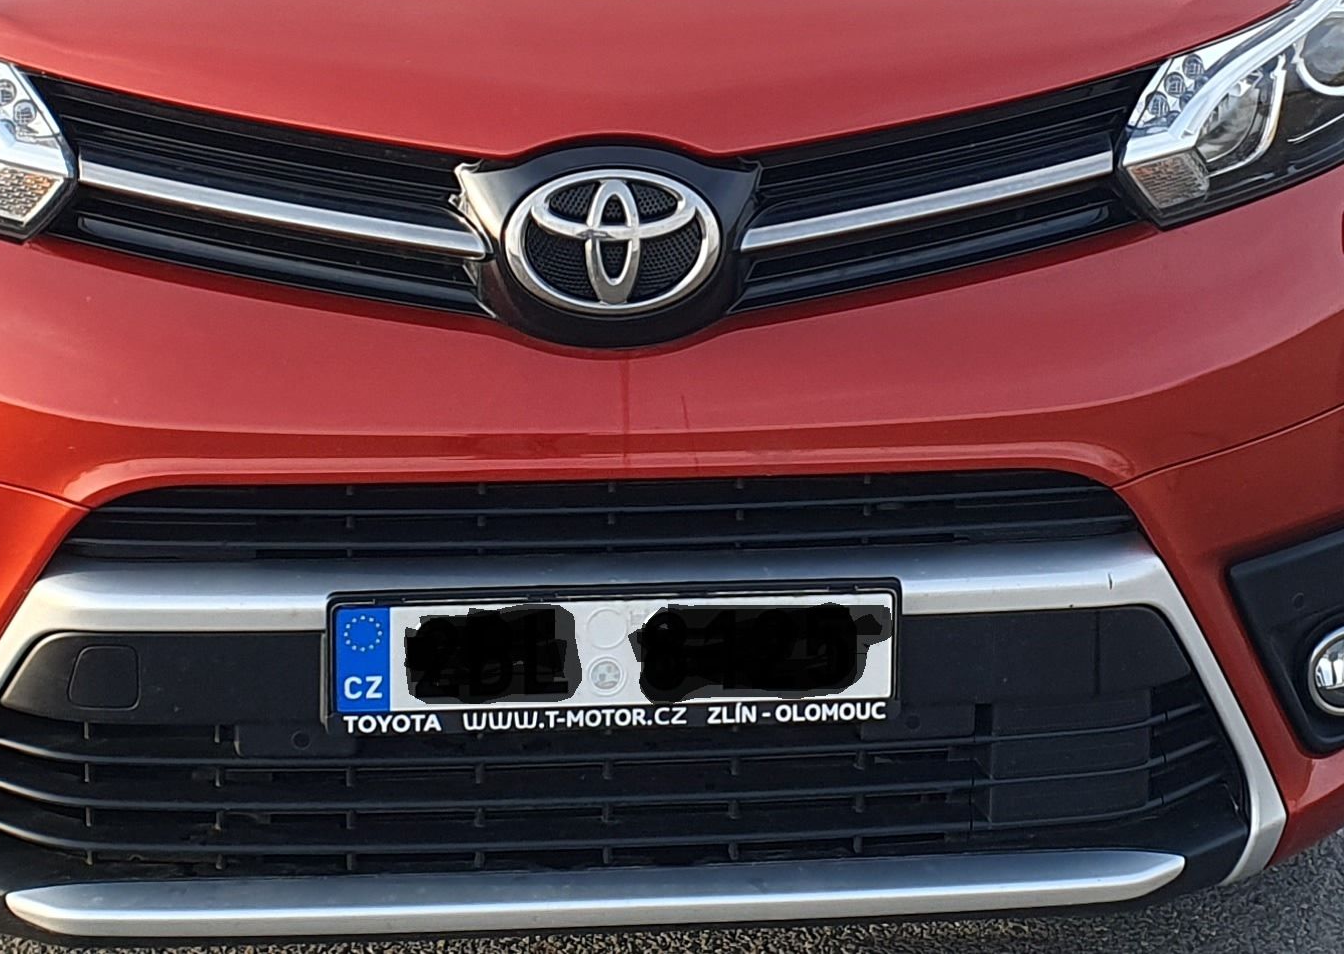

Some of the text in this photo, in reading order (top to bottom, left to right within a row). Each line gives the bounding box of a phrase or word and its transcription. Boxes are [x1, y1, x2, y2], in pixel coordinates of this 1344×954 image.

[343, 675, 384, 700] CZ
[343, 713, 442, 734] TOYOTA
[462, 706, 688, 731] WWW.T-MOTOR.CZ
[707, 702, 757, 725] ZLÍN
[775, 701, 887, 723] OLOMOUC
